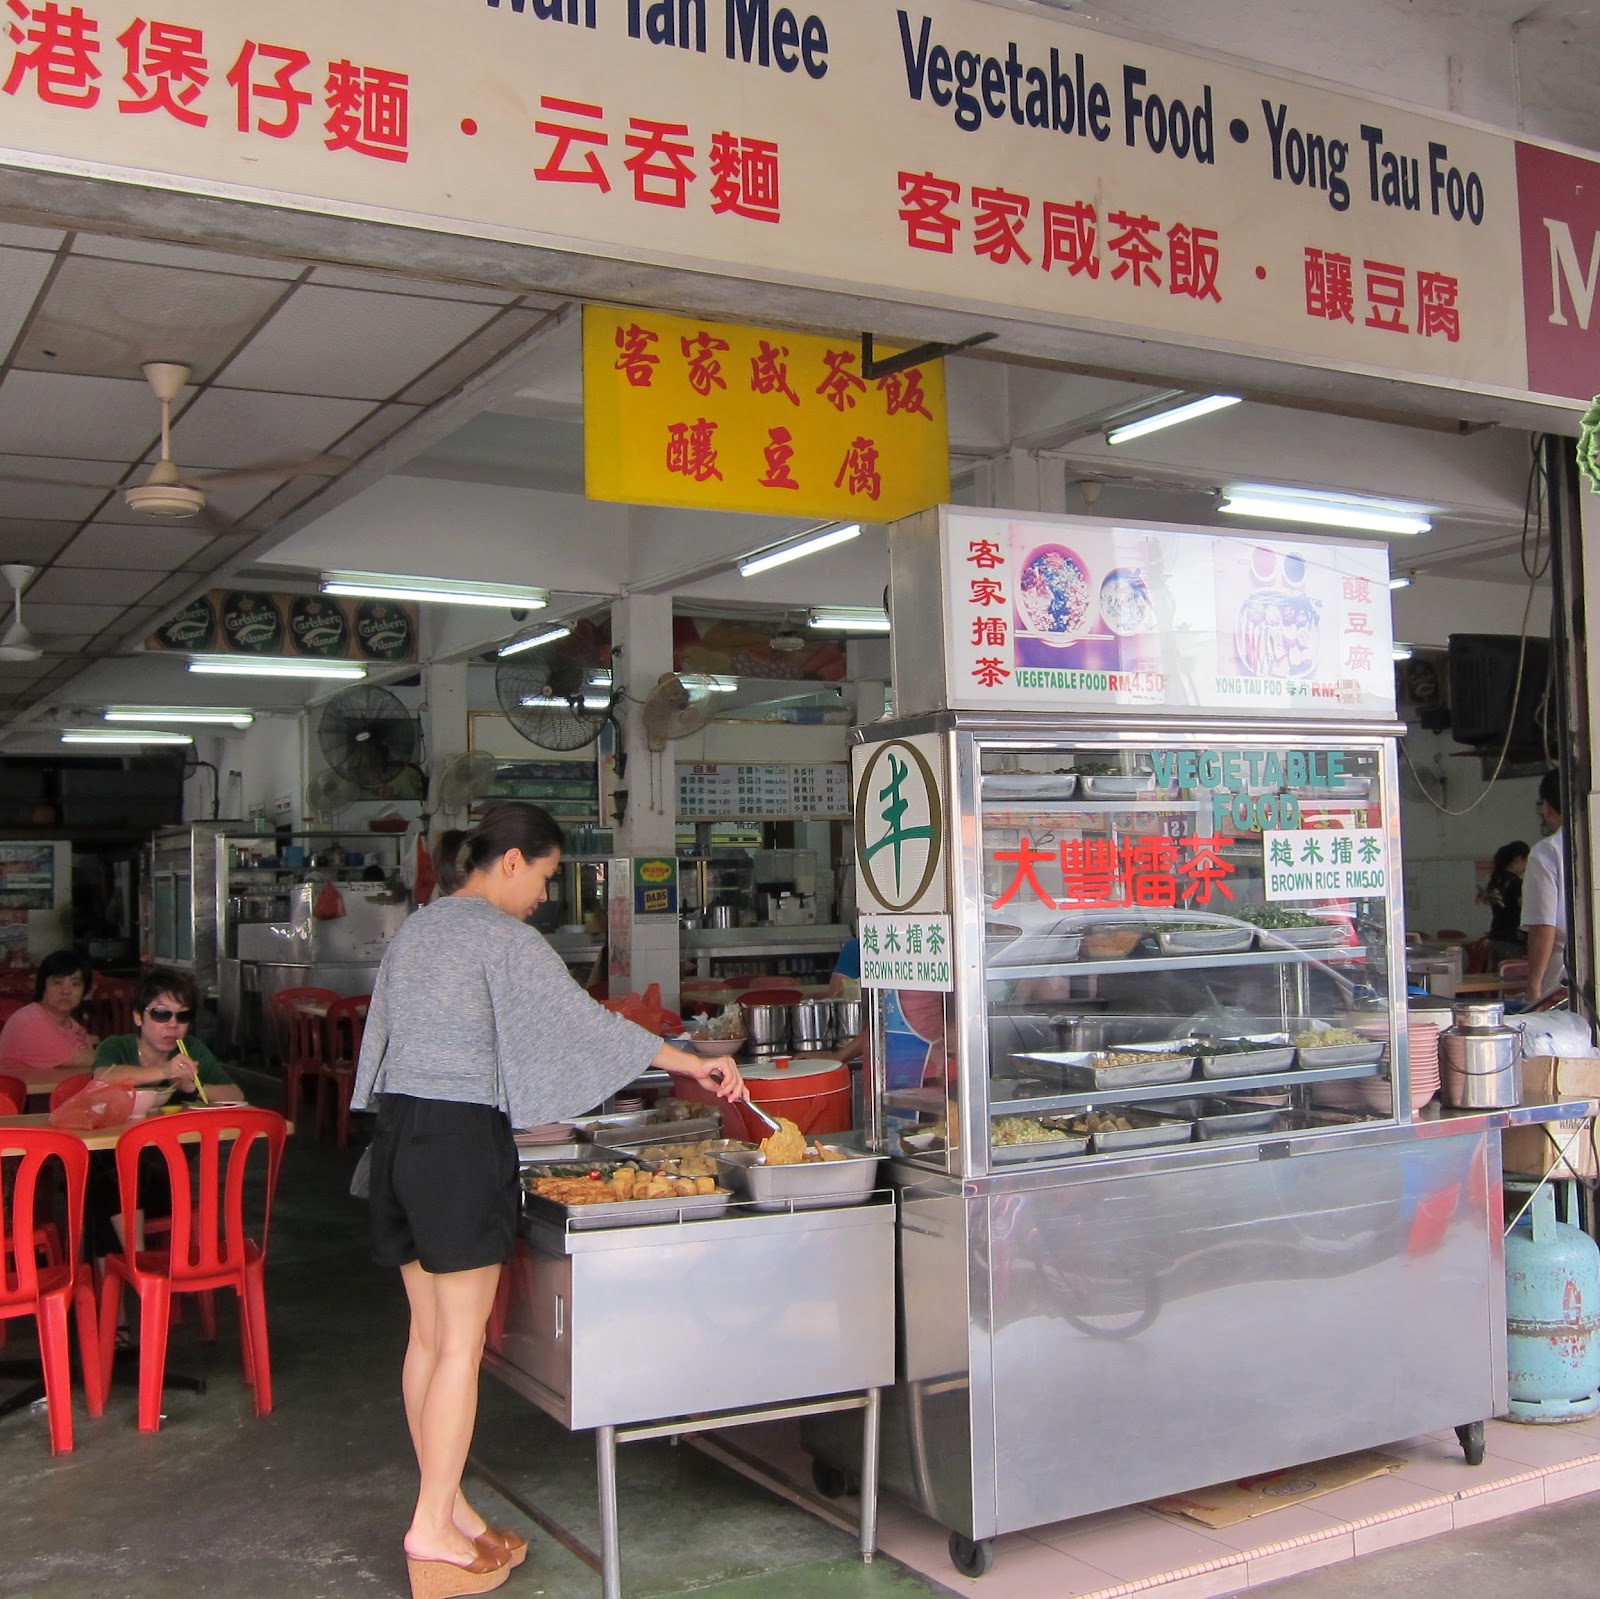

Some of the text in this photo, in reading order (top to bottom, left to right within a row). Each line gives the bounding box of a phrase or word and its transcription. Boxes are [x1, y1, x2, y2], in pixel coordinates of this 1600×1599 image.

[725, 0, 829, 80] Mee
[896, 9, 1485, 226] Vegetable Food Yong Tau Foo
[533, 94, 781, 224] 云吞麵
[897, 170, 1461, 343] 客家咸茶飯 釀豆腐
[614, 322, 934, 421] 客家咸茶飯
[665, 417, 882, 501] 釀豆腐
[225, 610, 277, 631] Carlsberg
[291, 613, 343, 634] Carlsberg
[357, 618, 407, 638] Carlsberg
[966, 539, 1012, 688] 客家擂茶
[1342, 576, 1374, 672] 釀豆腐
[171, 629, 207, 642] Pilsner
[239, 631, 274, 645] Pilsner
[305, 634, 340, 648] Pilsner
[372, 639, 404, 651] Pilsner
[1015, 670, 1077, 689] VEGETABLE
[1079, 673, 1107, 691] FOOD
[1215, 677, 1242, 694] YONG
[1243, 679, 1262, 695] TAU
[1264, 680, 1282, 695] FOO
[1152, 751, 1346, 788] VEGETABLE
[1213, 793, 1300, 831] FOOD
[1270, 836, 1381, 867] 糙米擂茶
[992, 834, 1236, 910] 大豐擂茶
[1271, 872, 1312, 892] BROWN
[1315, 871, 1340, 889] RICE
[863, 923, 945, 955] 糙米擂茶
[864, 961, 893, 980] BROWN
[894, 961, 913, 980] RICE
